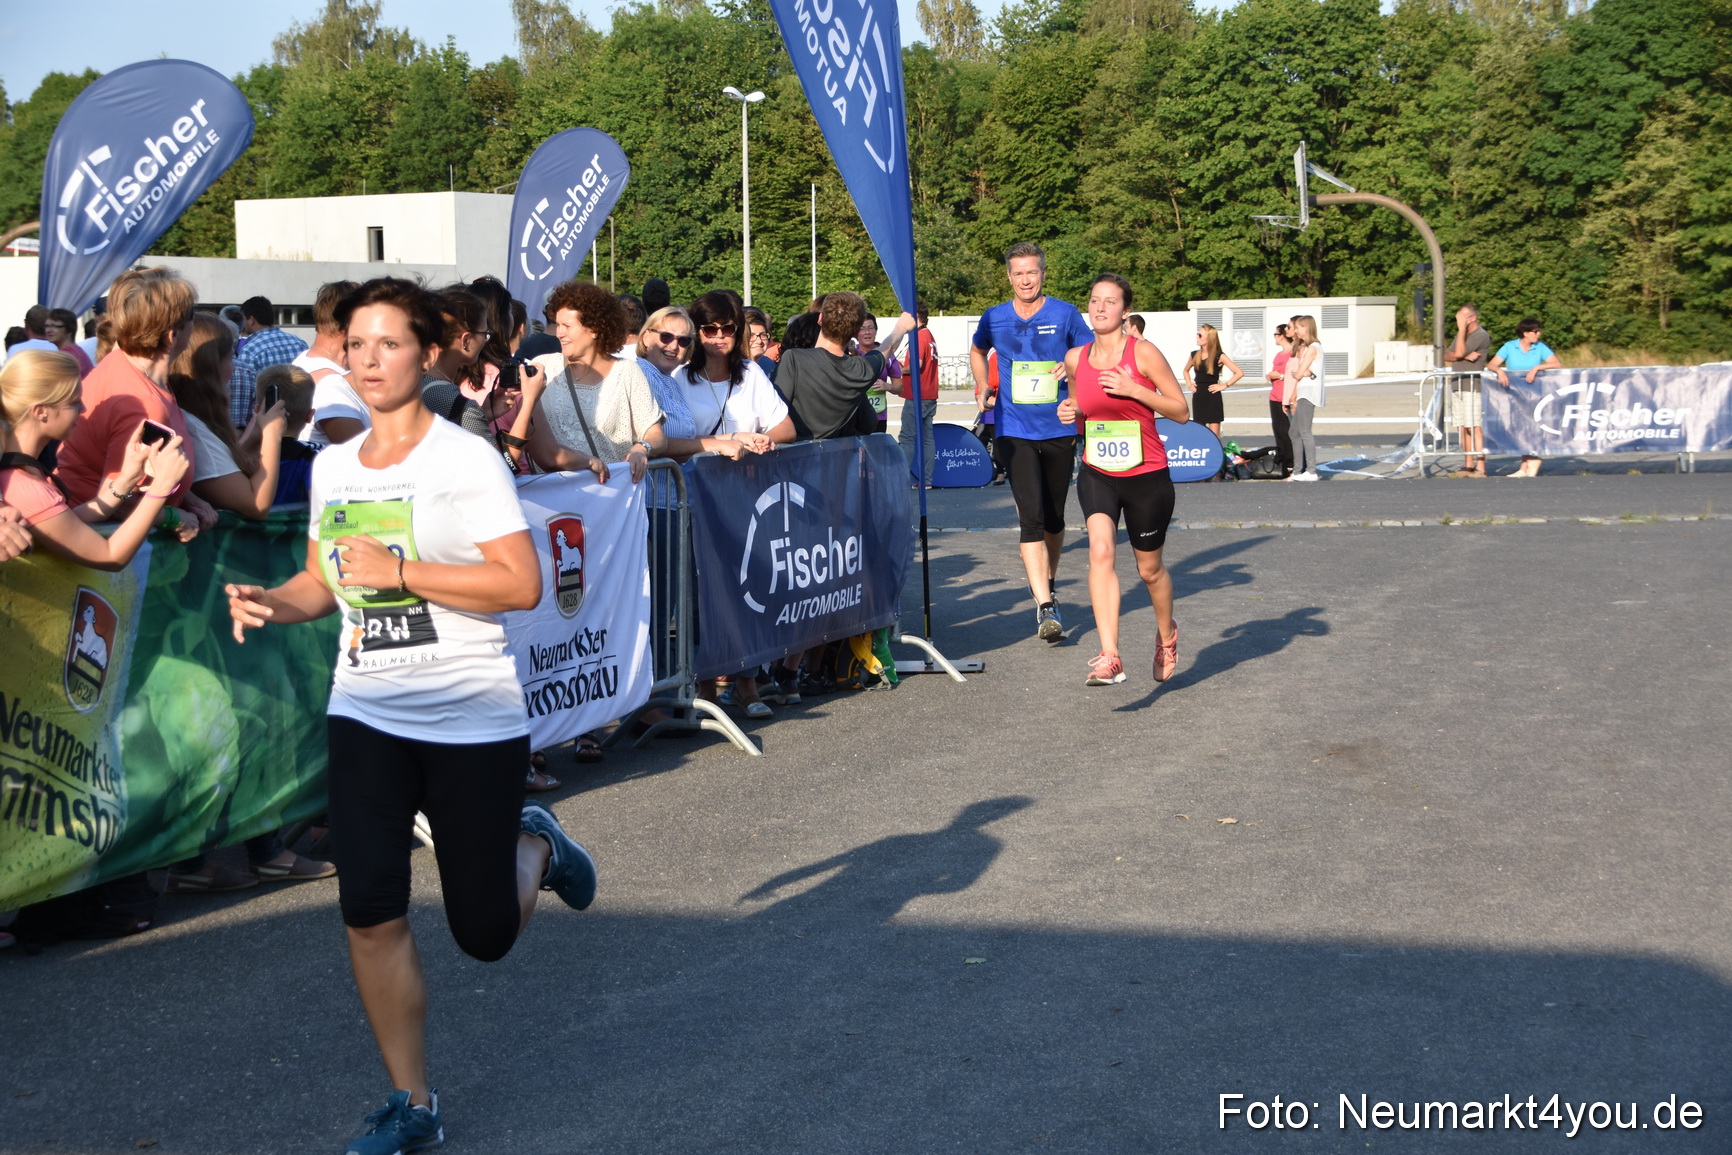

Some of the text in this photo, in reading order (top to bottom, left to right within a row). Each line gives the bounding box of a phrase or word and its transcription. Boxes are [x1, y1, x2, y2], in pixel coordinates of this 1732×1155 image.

[84, 98, 208, 233] Fischer
[123, 129, 220, 234] AUTOMOBILE
[536, 154, 602, 262] Fischer
[560, 174, 610, 260] AUTOMOBILE
[1031, 379, 1039, 392] 7
[1562, 402, 1692, 428] Fischer
[1573, 428, 1680, 441] AUTOMOBILE
[1097, 441, 1130, 457] 908
[1167, 446, 1210, 459] cher
[503, 451, 517, 471] SONY
[368, 483, 417, 493] WOHNFORMEL
[408, 606, 423, 615] NM
[562, 592, 578, 609] 1628
[775, 583, 862, 626] AUTOMOBILE
[363, 652, 439, 668] RAUMWERK
[529, 627, 607, 676] Neumarkter
[73, 679, 94, 704] 1628
[0, 692, 121, 799] Neumarkte
